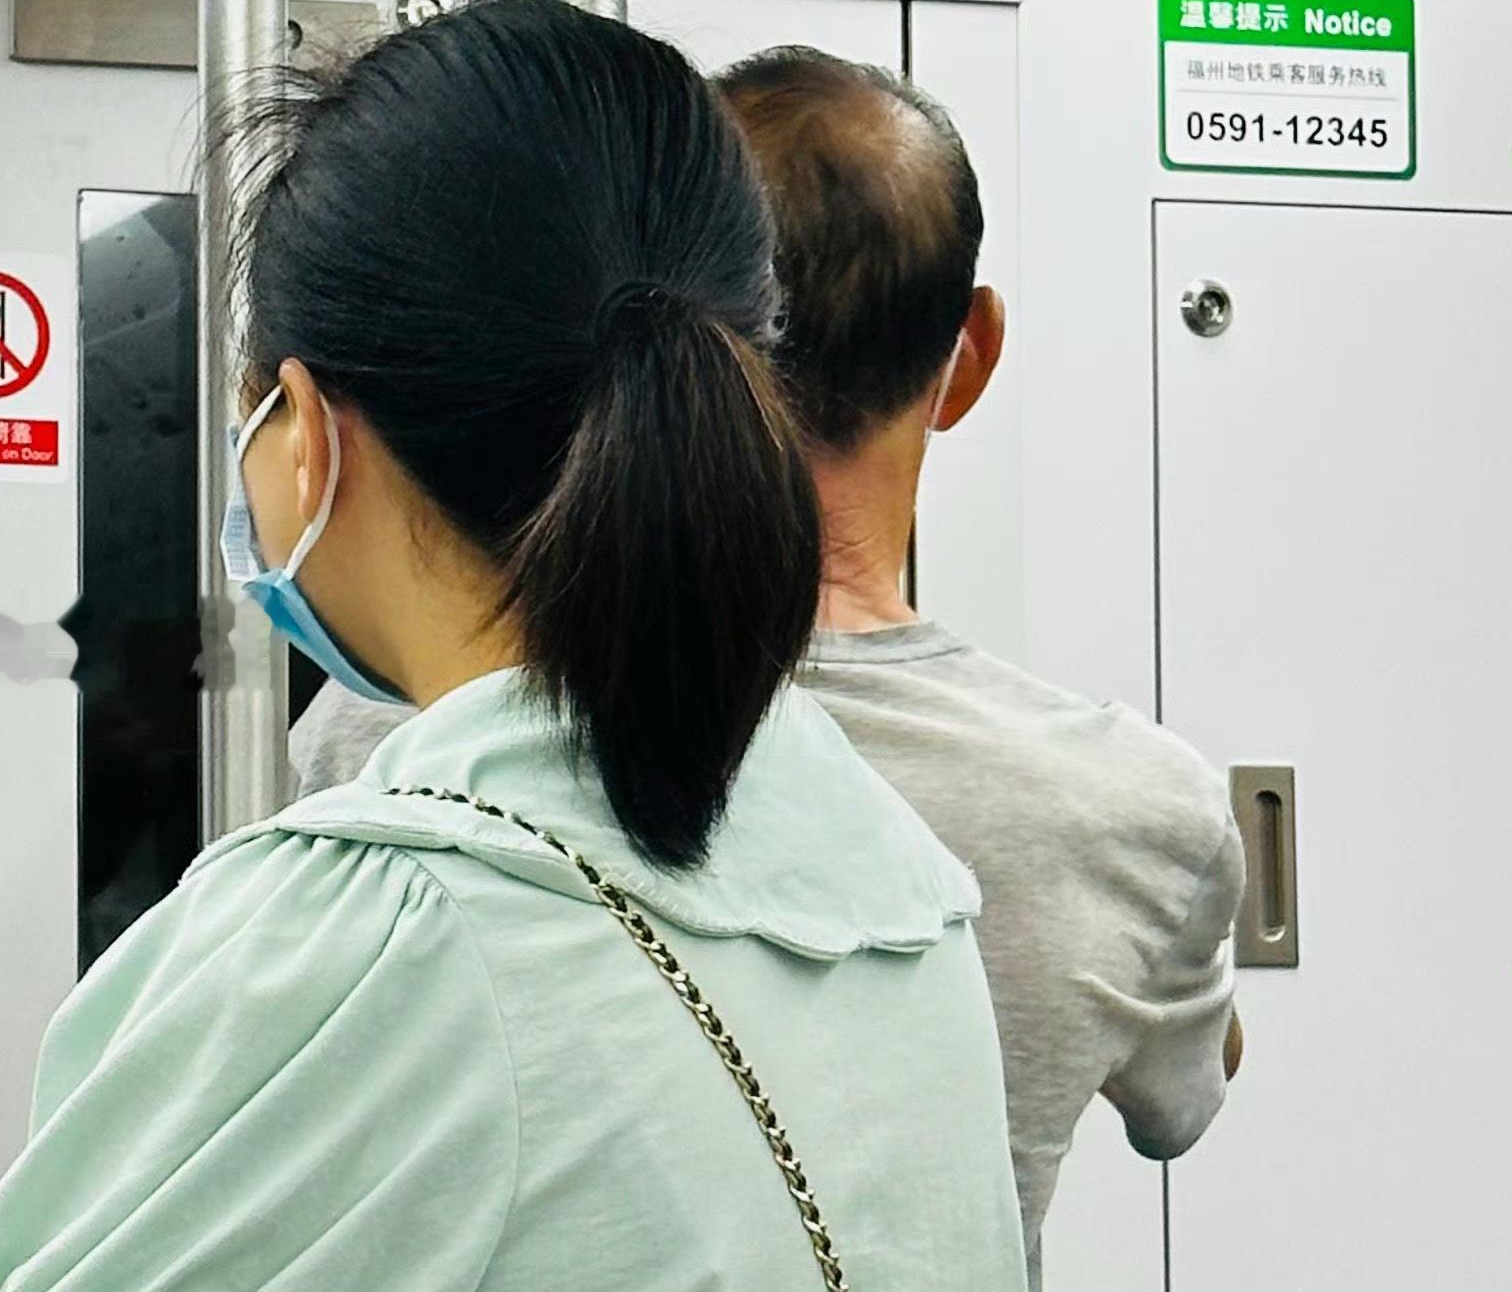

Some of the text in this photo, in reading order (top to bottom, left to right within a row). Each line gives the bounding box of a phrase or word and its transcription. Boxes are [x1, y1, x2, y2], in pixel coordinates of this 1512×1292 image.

[1179, 0, 1392, 37] 温馨提示 Notice
[1187, 59, 1387, 87] 福州地铁乘客服务热线
[1187, 111, 1388, 148] 0591-12345
[21, 447, 55, 461] Door
